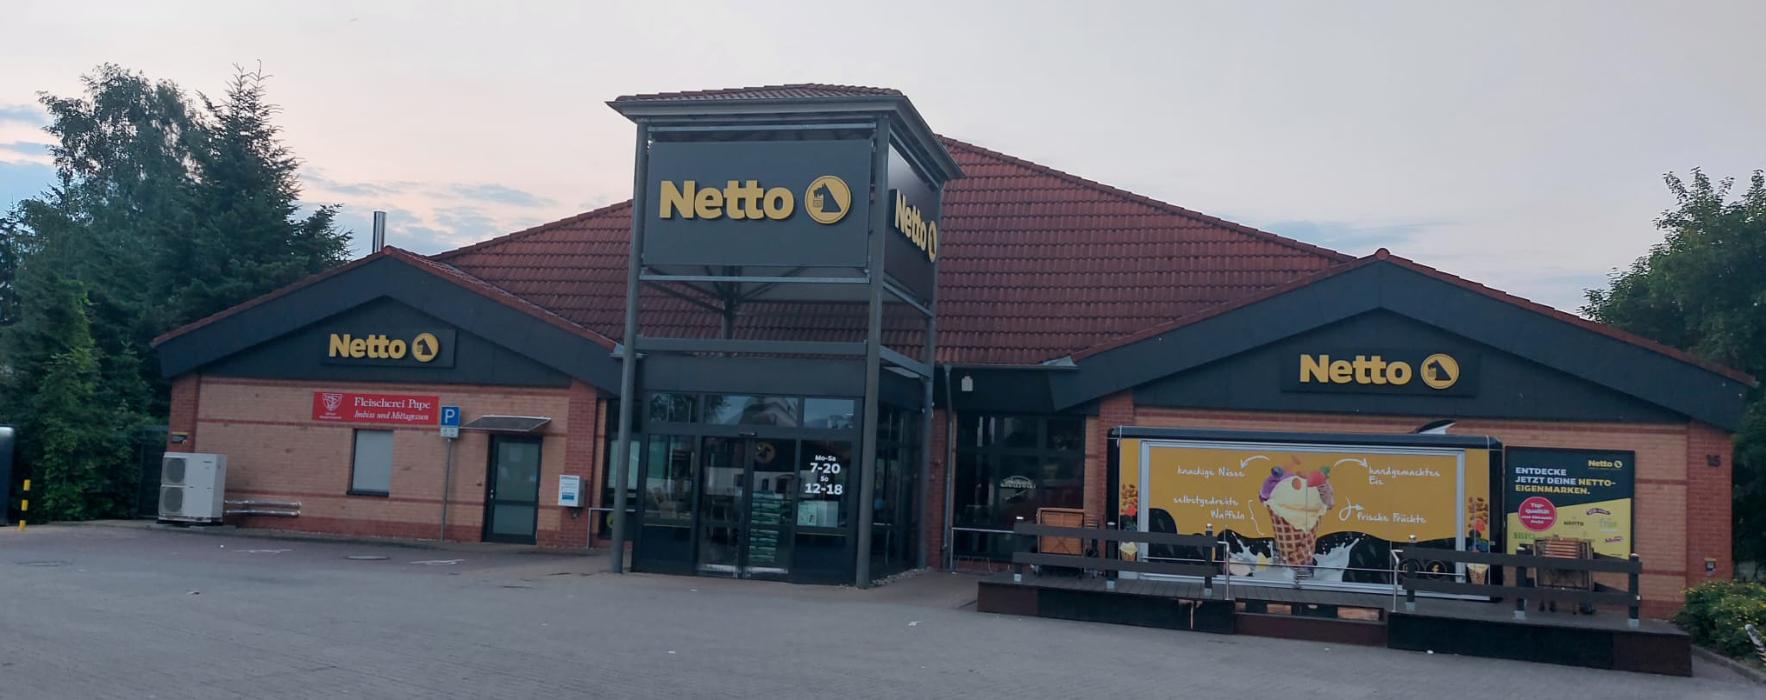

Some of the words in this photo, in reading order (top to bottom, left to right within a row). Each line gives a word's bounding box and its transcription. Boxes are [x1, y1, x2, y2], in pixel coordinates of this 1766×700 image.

[659, 180, 795, 220] Netto
[895, 189, 927, 251] Netto
[329, 333, 406, 359] Netto
[1299, 354, 1412, 385] Netto
[354, 397, 405, 408] Fleischerei
[408, 399, 431, 410] Pape
[445, 408, 455, 424] P
[810, 462, 841, 474] 7-20
[1369, 466, 1440, 478] handgemachtes
[1515, 467, 1566, 476] ENTDECKE
[1514, 476, 1544, 484] JETZT
[1578, 478, 1616, 487] NETTO-
[805, 483, 843, 495] 12-18
[1515, 485, 1590, 495] EIGENMARKEN.
[1211, 508, 1245, 520] Waffeln
